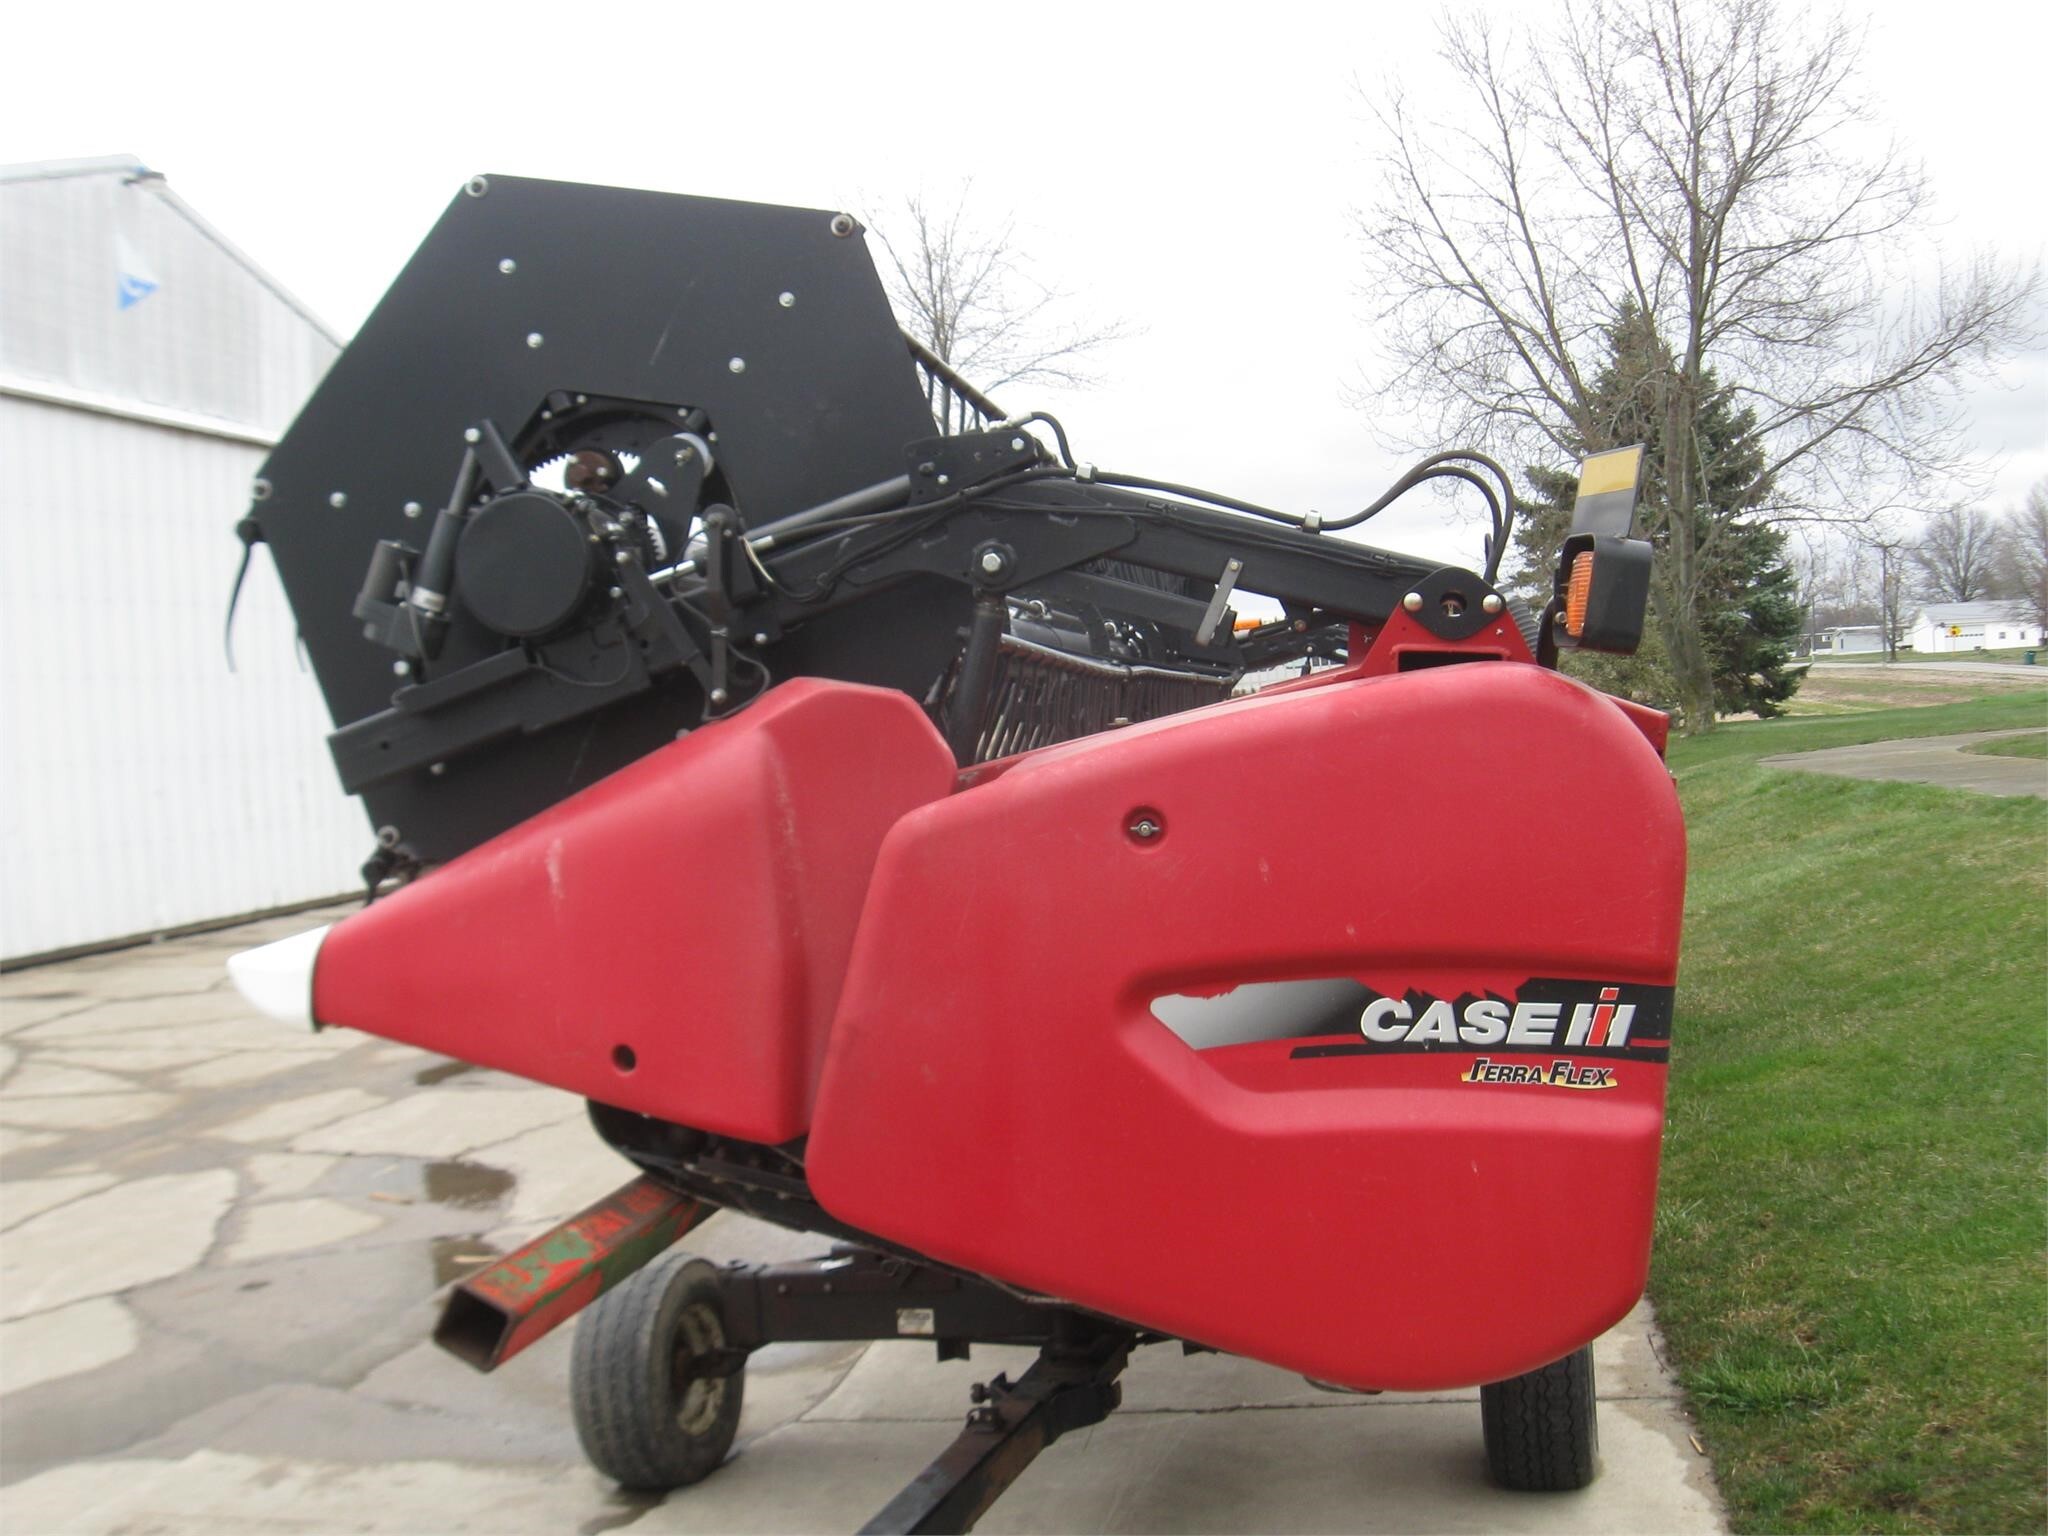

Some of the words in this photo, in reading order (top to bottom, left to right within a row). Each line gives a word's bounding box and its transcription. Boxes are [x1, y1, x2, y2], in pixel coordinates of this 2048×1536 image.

[1360, 998, 1562, 1044] CASE
[1469, 1057, 1543, 1085] TERRA
[1548, 1060, 1613, 1087] FLEX
